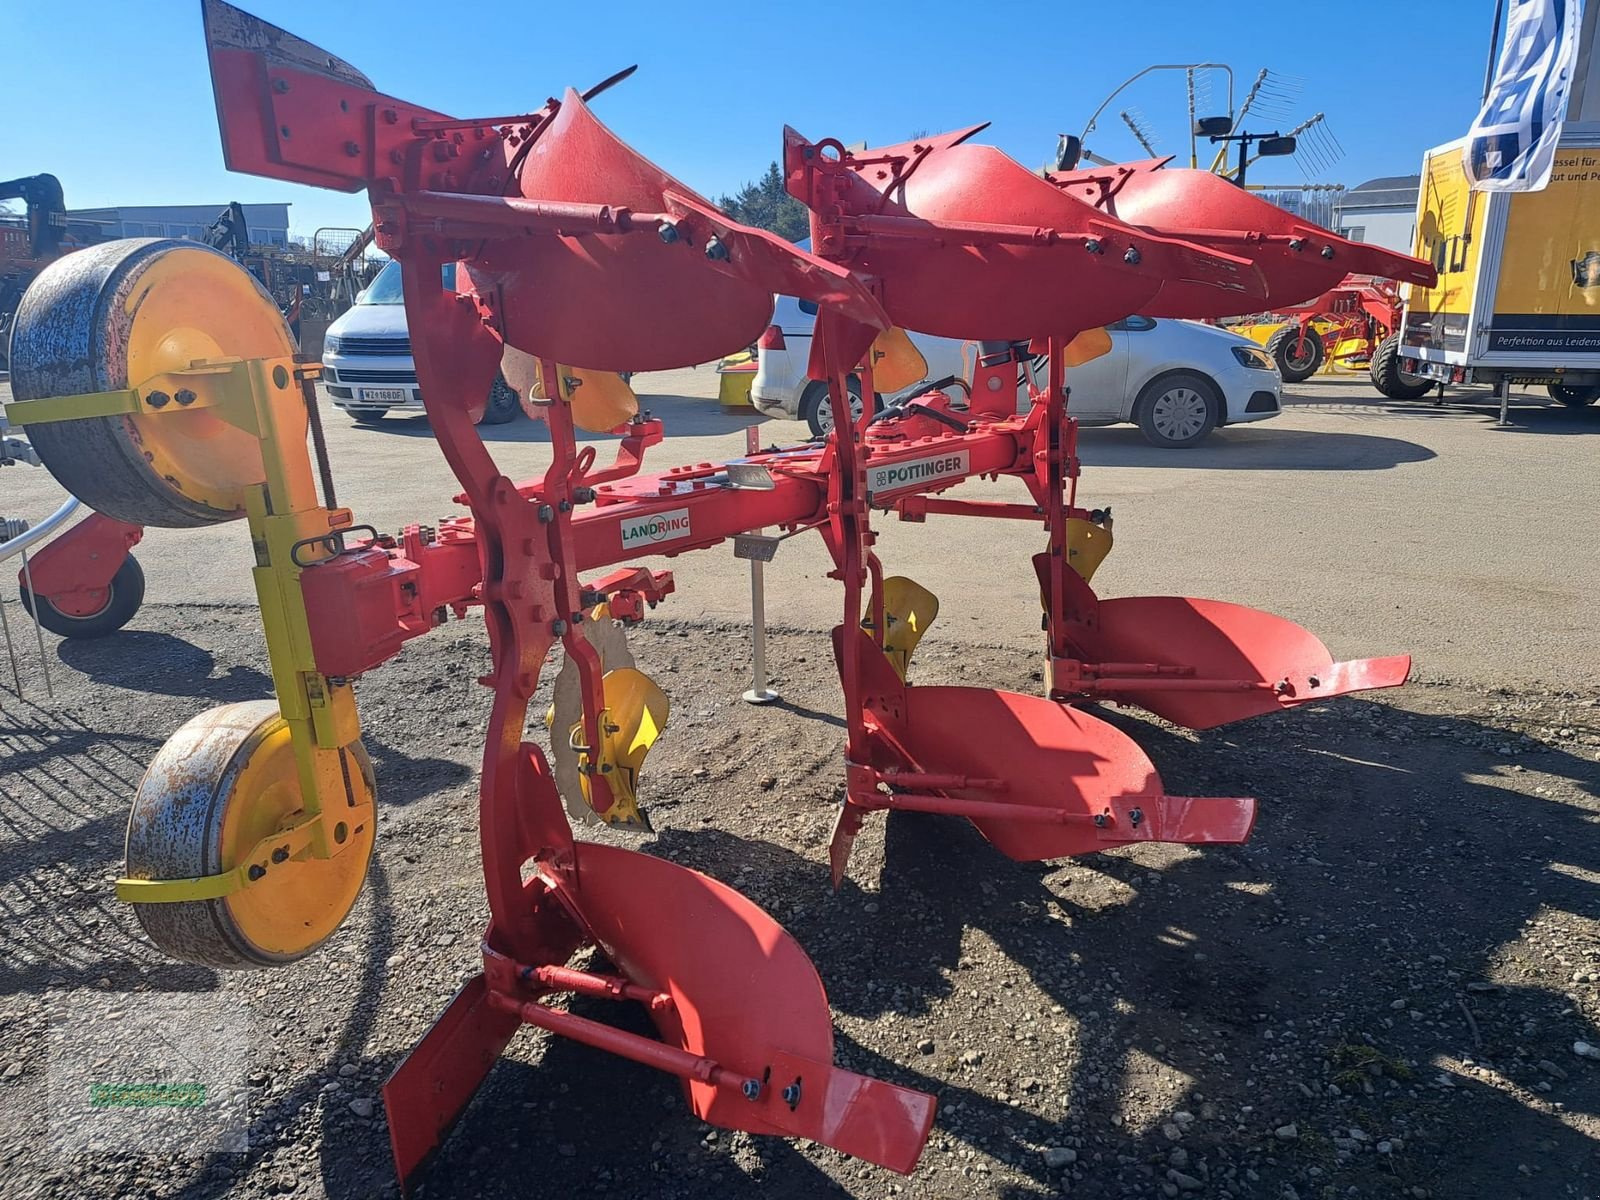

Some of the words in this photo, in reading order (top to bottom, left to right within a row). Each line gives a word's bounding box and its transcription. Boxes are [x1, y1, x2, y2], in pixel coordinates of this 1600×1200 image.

[1567, 172, 1588, 181] und
[1497, 336, 1544, 347] Perfektion
[1547, 338, 1563, 346] aus
[622, 517, 689, 540] LANDRING
